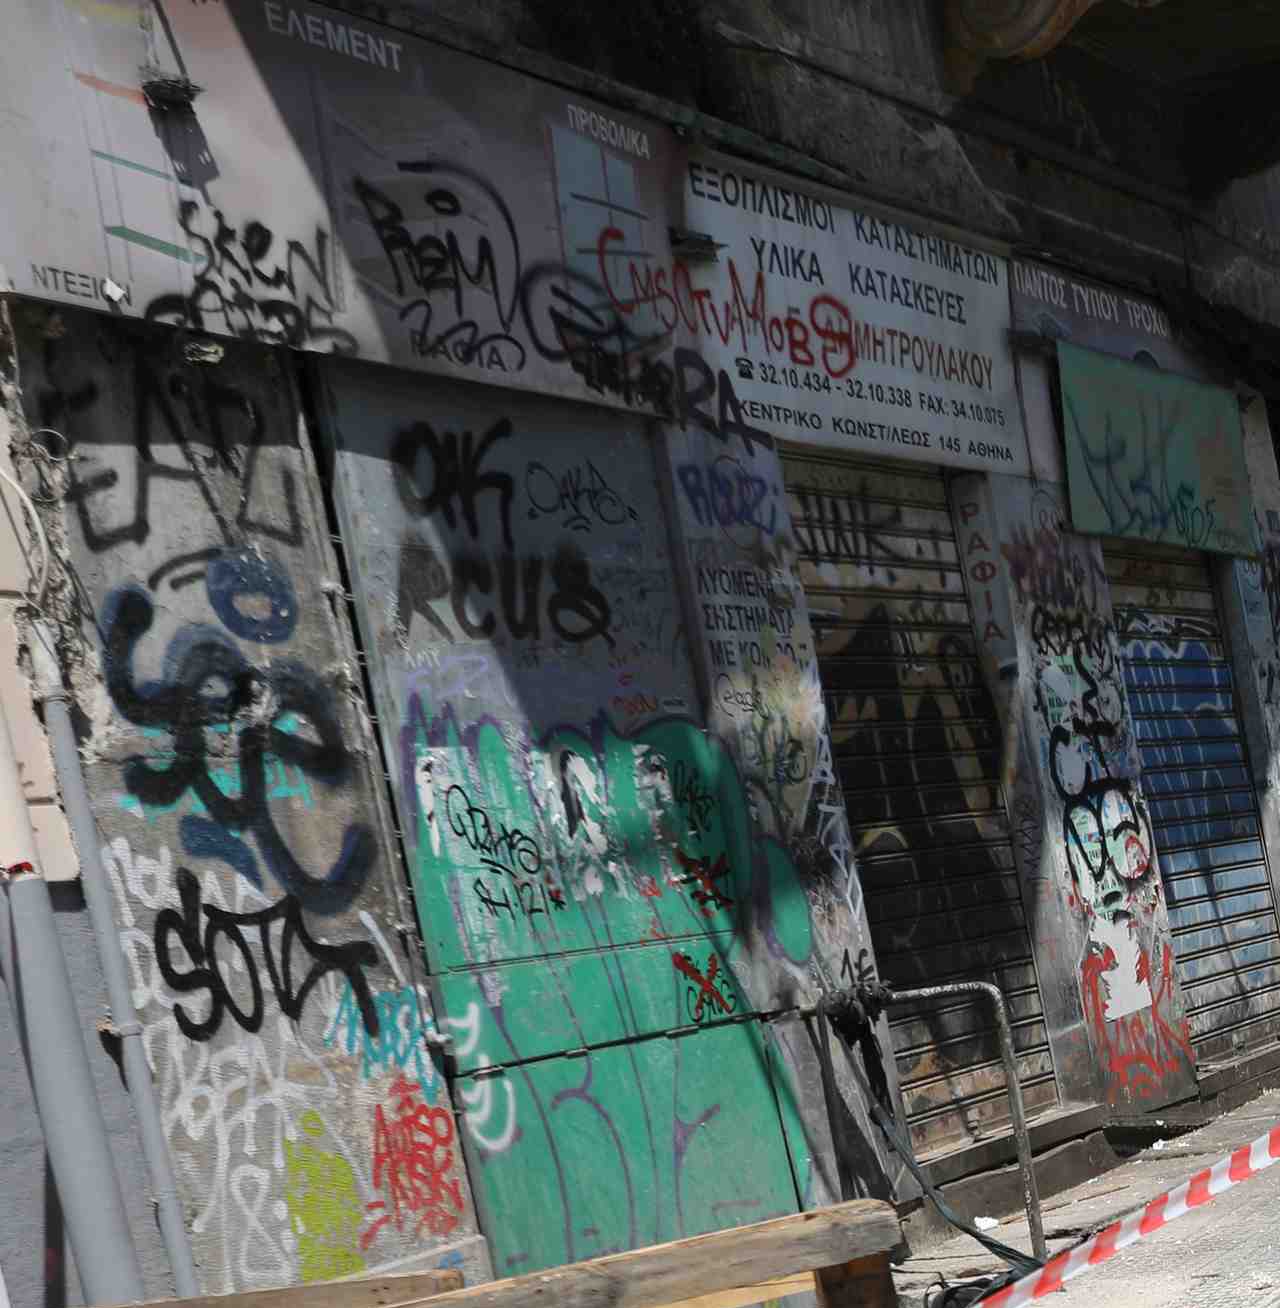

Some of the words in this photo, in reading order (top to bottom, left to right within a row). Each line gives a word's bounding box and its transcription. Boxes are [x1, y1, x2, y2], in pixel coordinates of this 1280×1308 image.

[688, 162, 835, 233] ΕΞΟΠΛΙΣΜΟΙ
[852, 211, 999, 286] ΚΑΤΑΣΤΗΜΑΤΩΝ
[750, 238, 824, 285] ΥΛΙΚΑ
[848, 261, 967, 325] ΚΑΤΑΣΚΕΥΕΣ
[759, 362, 832, 393] 32.10.434
[740, 400, 823, 430] ΚΕΝΤΡΙΚΟ
[939, 436, 961, 453] 145
[967, 442, 1015, 461] ΑΘΗΝΑ
